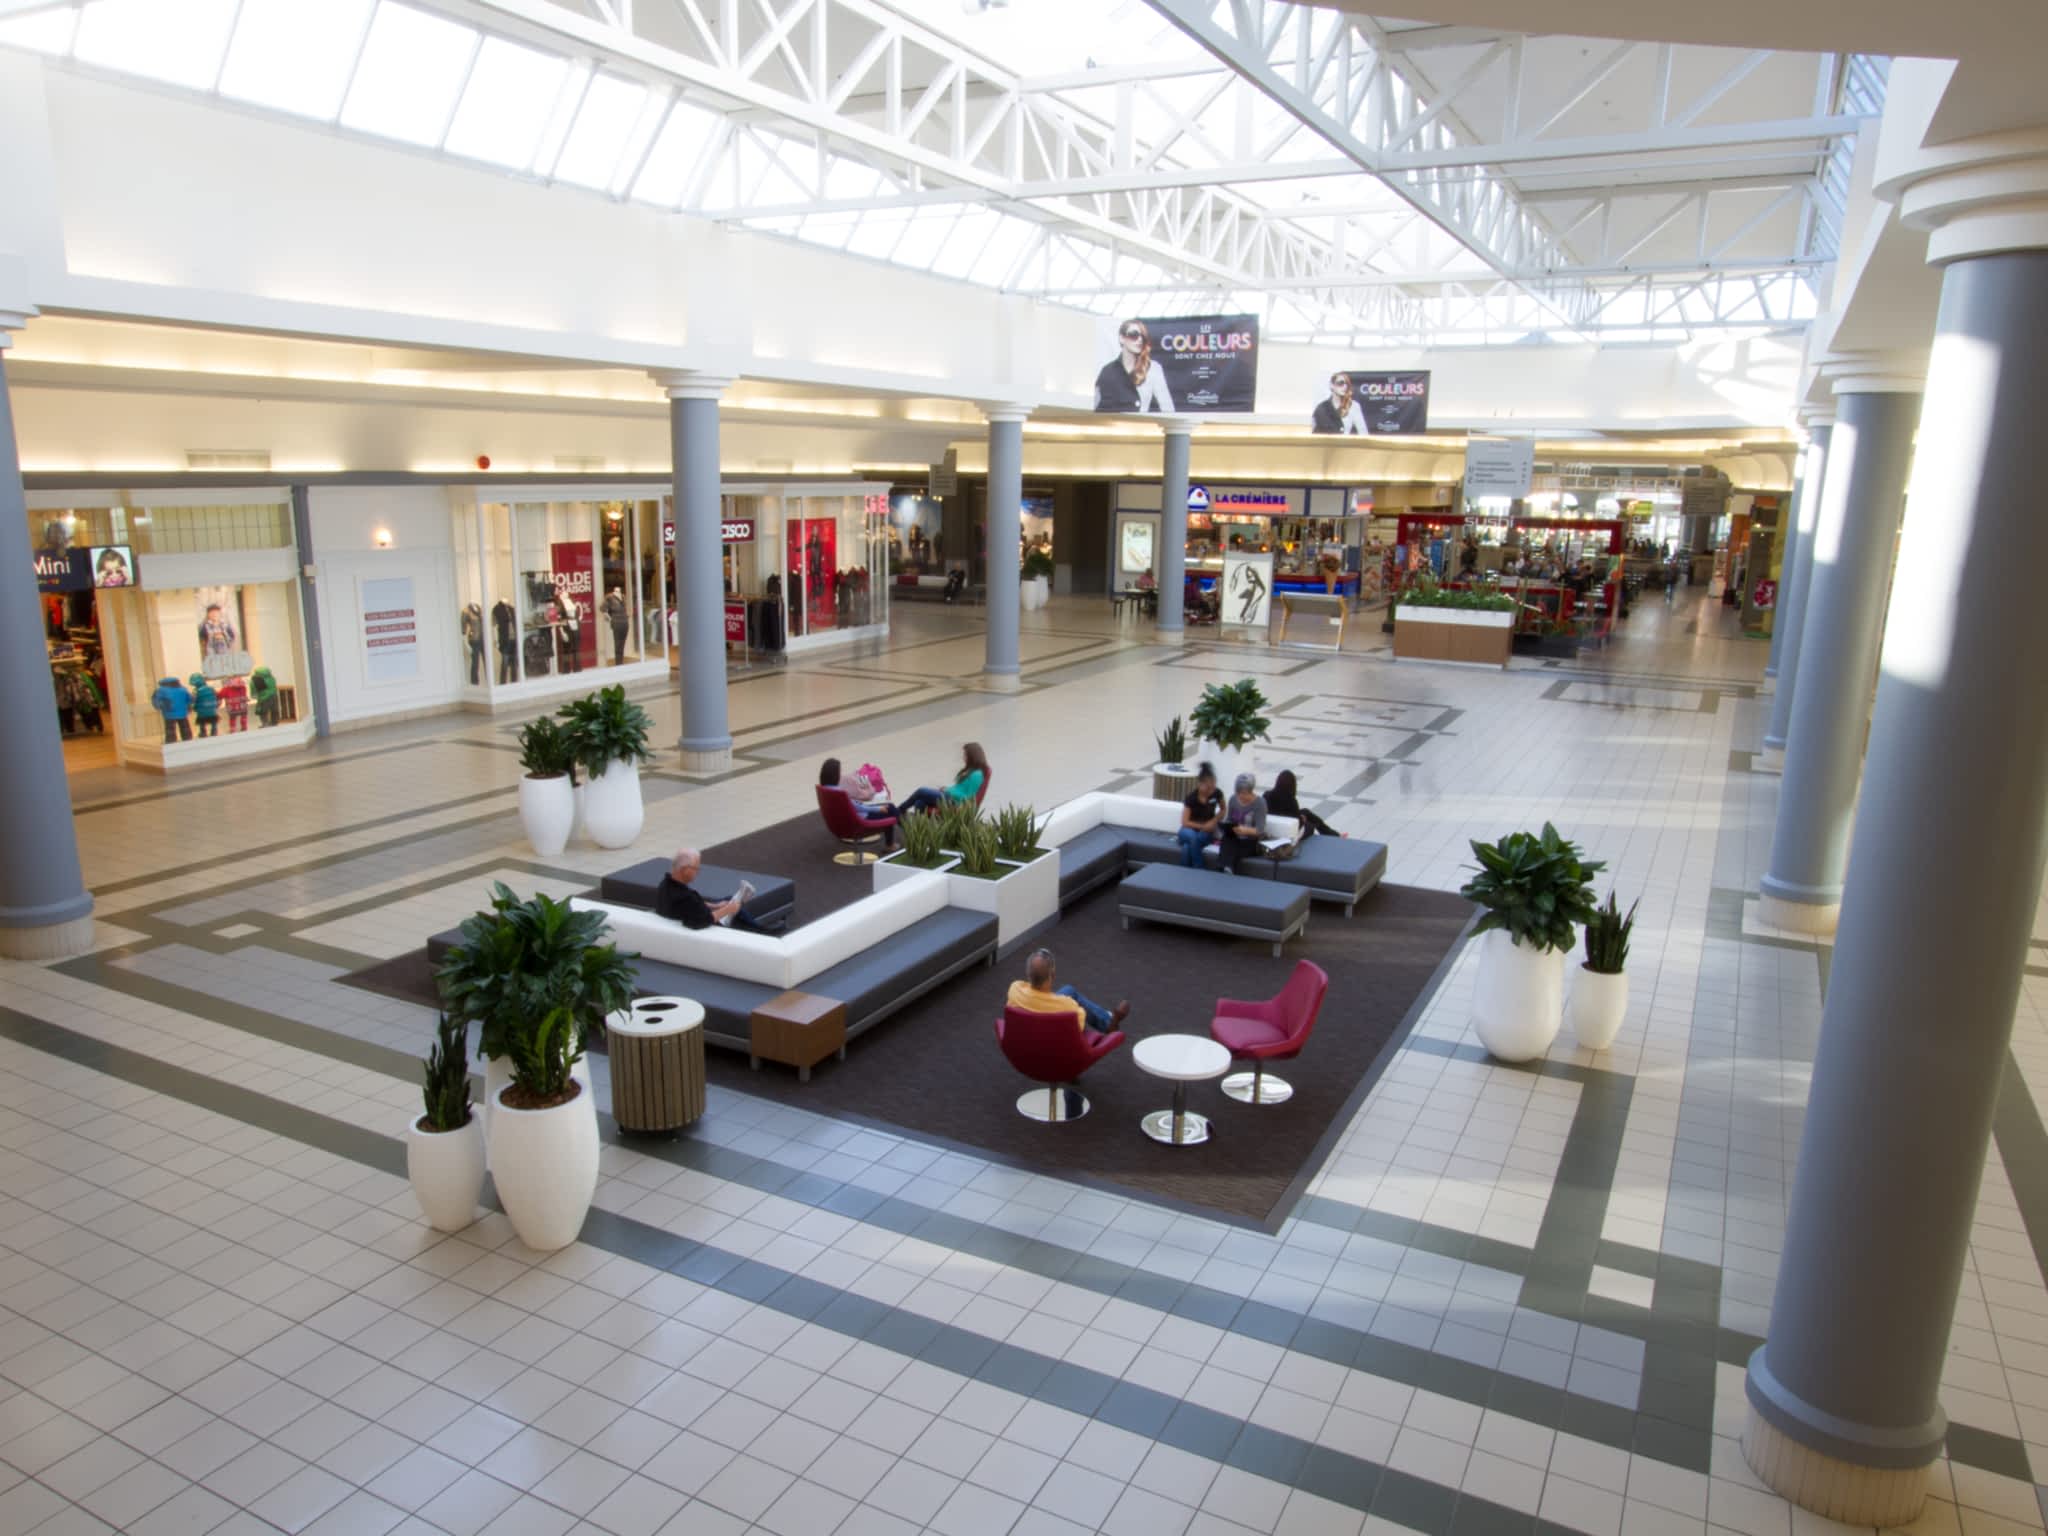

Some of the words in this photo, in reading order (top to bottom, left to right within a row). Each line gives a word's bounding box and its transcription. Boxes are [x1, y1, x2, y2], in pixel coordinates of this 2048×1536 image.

[1161, 332, 1251, 351] COULEURS
[1360, 382, 1424, 395] COULEURS
[1216, 494, 1229, 503] LA
[33, 556, 71, 575] Mini
